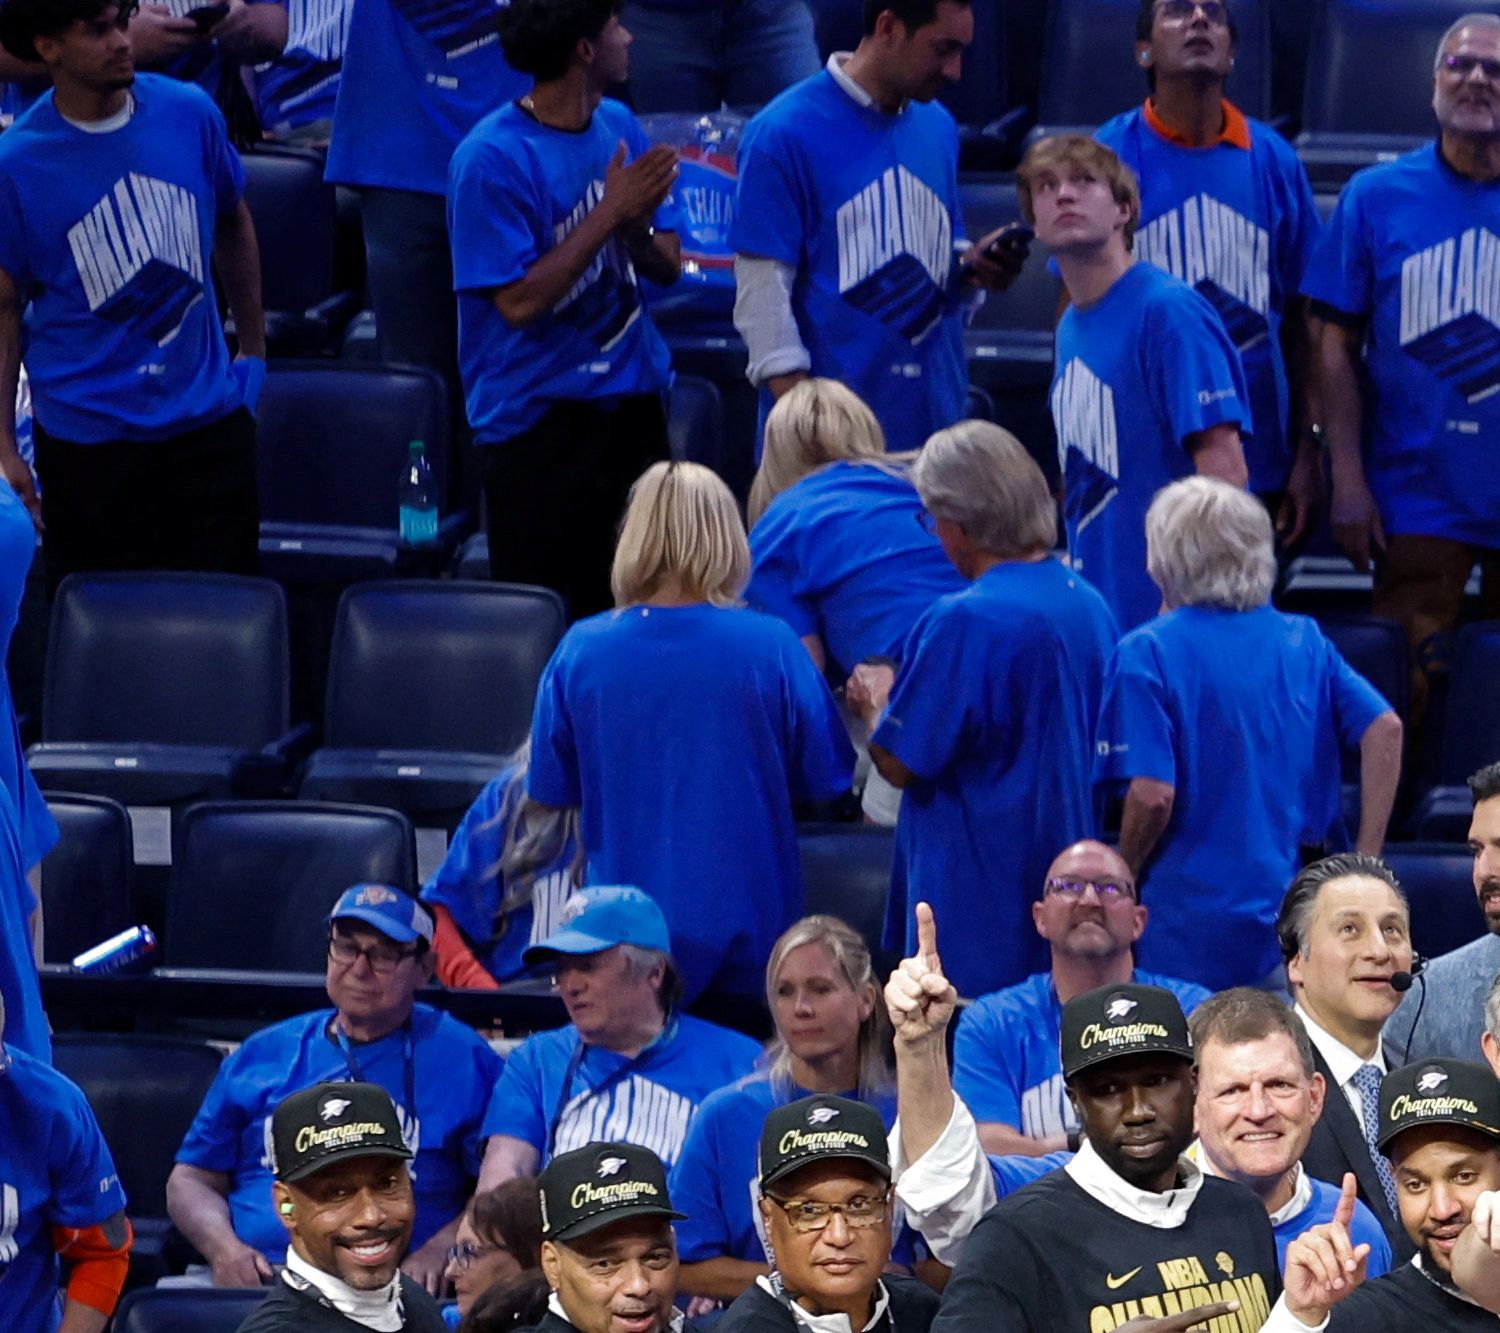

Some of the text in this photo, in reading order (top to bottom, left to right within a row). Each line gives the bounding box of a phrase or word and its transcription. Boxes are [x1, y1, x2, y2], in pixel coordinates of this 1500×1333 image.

[1080, 1022, 1168, 1048] Champions
[1390, 1094, 1478, 1120] Champions
[296, 1121, 384, 1152] Champions
[778, 1128, 869, 1156] Champions
[570, 1181, 658, 1210] Champions
[1158, 1257, 1207, 1290] NBA
